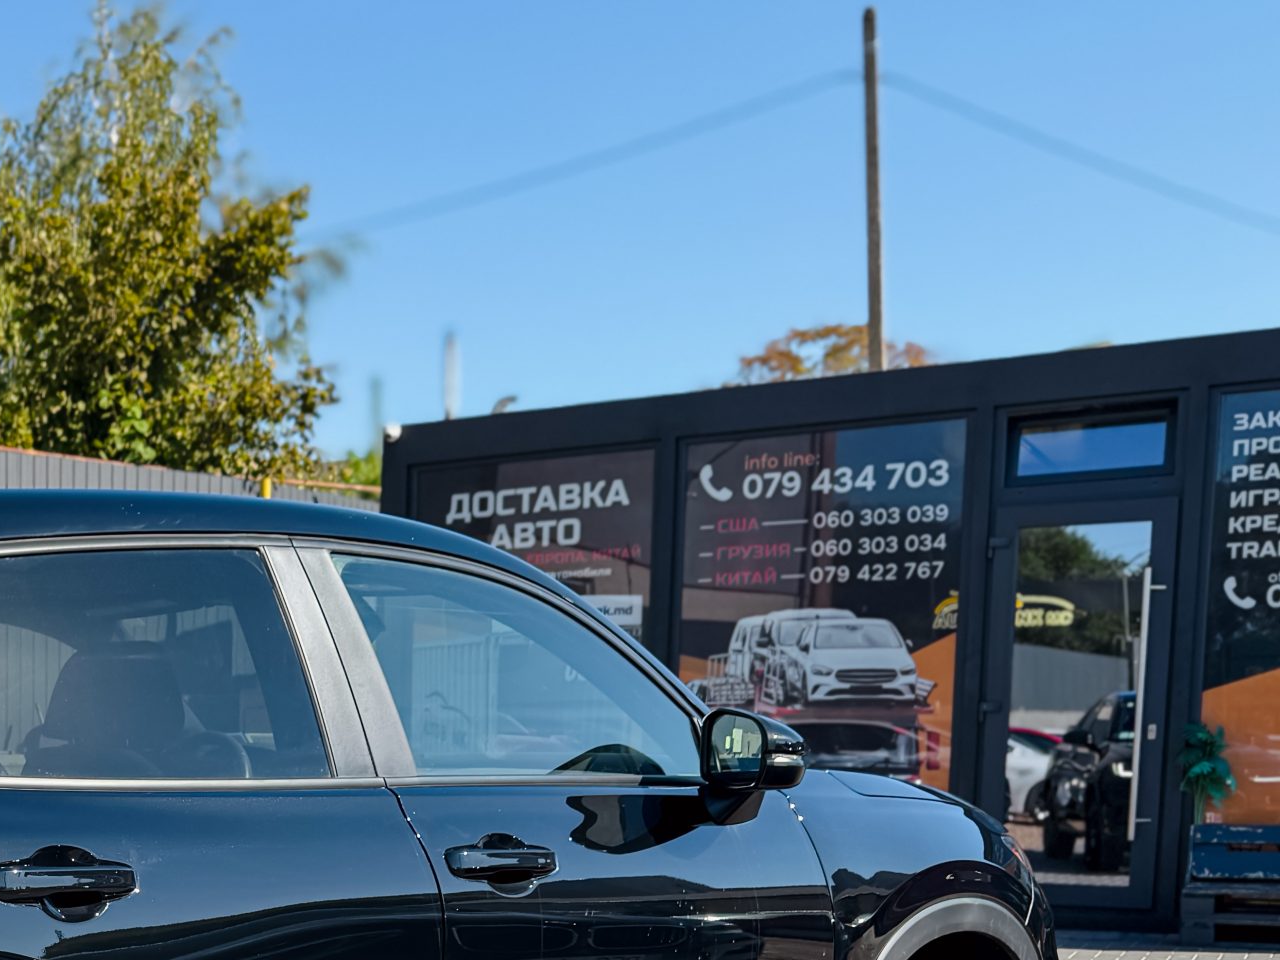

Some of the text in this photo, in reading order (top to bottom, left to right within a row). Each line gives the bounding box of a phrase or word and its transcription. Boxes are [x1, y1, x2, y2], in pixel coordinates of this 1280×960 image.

[744, 451, 820, 471] info line:
[742, 459, 950, 500] 079 434 703
[446, 479, 630, 525] ДОСТАВКА
[717, 504, 949, 533] США 060 303 039
[490, 518, 581, 550] АВТО
[716, 533, 947, 561] ГРУЗИЯ 060 303 034
[715, 561, 945, 586] КИТАЙ 079 422 767
